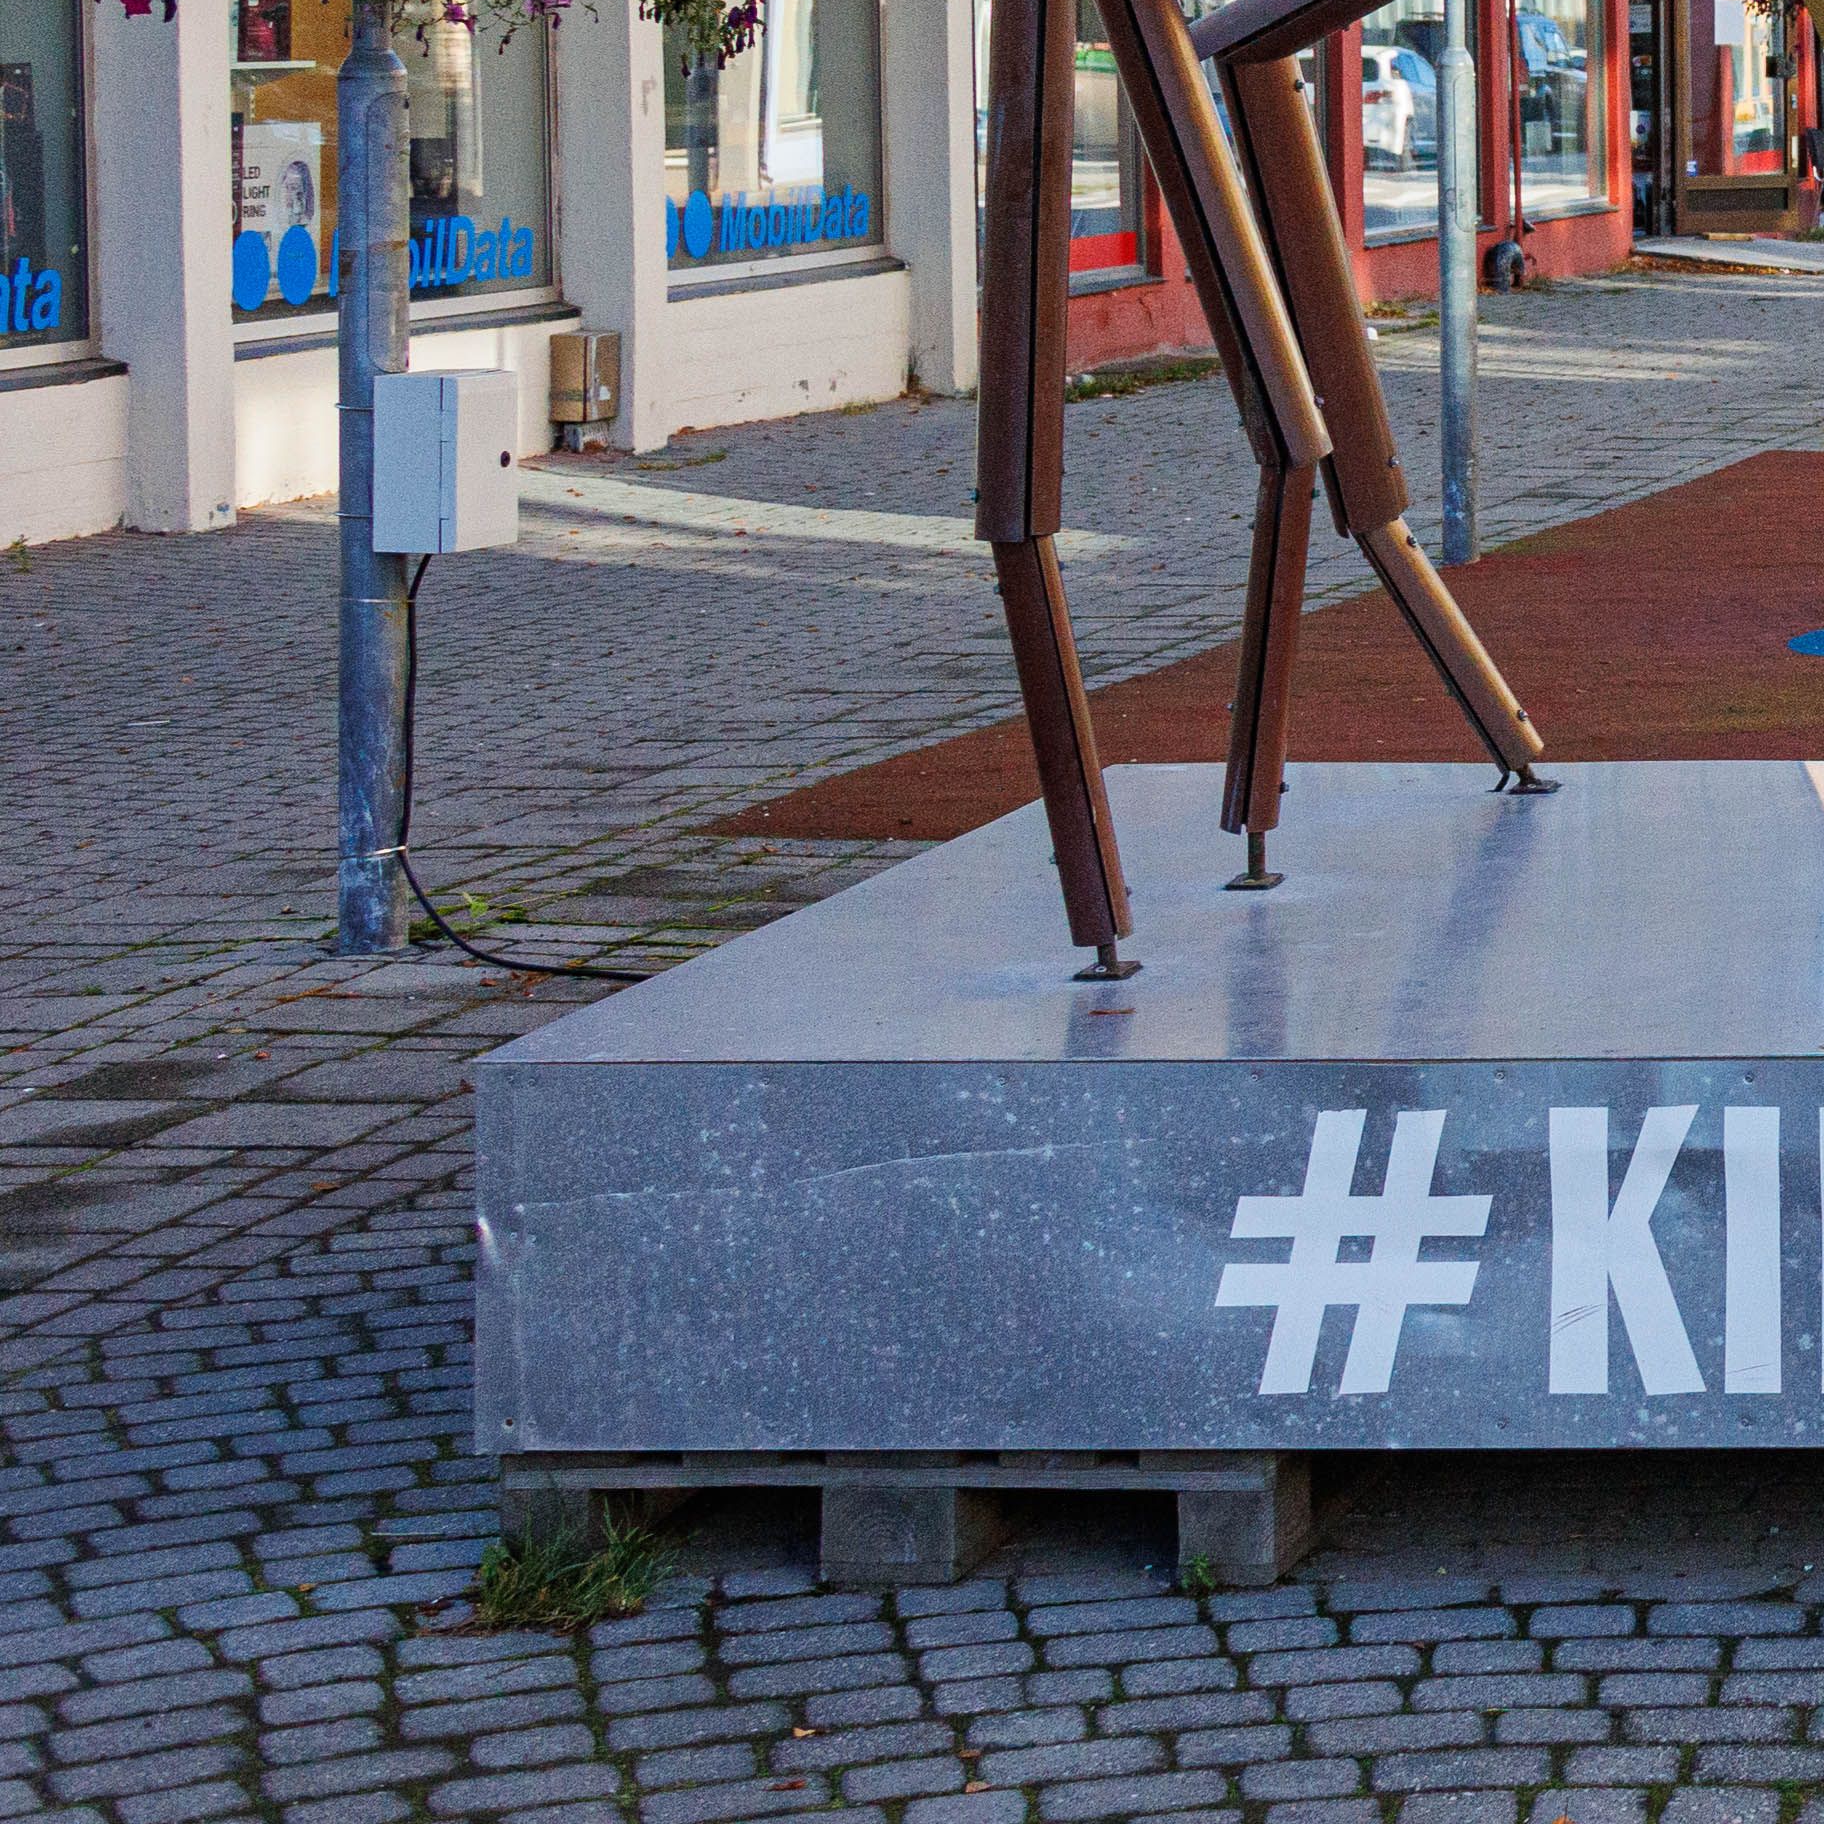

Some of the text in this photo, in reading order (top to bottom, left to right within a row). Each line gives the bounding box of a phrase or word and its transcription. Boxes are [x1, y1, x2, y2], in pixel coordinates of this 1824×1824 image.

[243, 166, 261, 179] LED
[243, 185, 271, 200] LIGHT
[719, 183, 871, 253] MobilData
